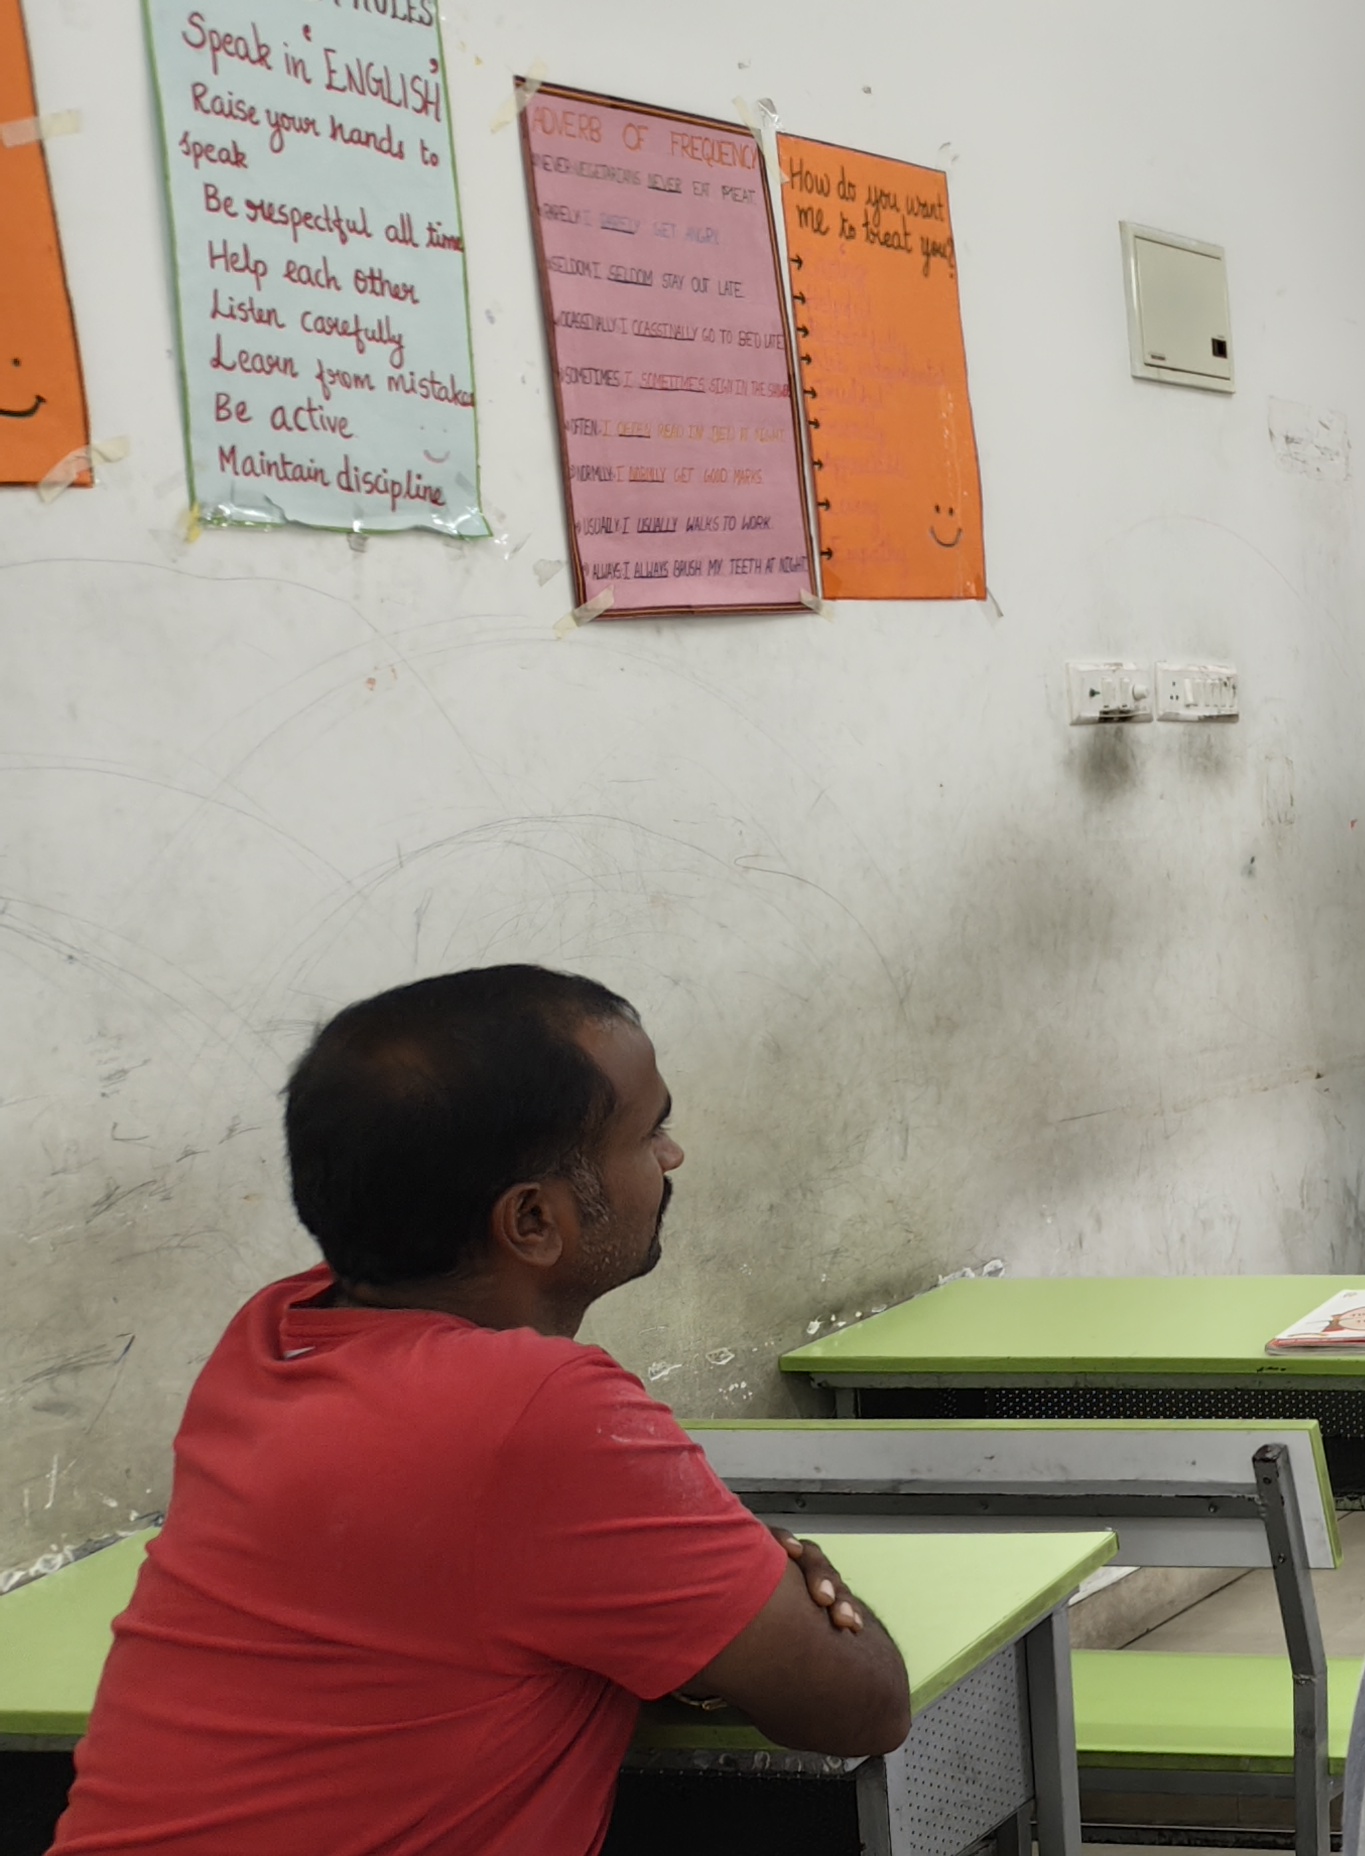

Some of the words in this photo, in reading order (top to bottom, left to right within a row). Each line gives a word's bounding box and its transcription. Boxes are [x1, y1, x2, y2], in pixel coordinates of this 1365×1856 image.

[181, 12, 272, 74] Speak
[284, 42, 312, 84] in
[179, 131, 248, 170] speak
[191, 83, 260, 125] Raise
[266, 108, 321, 153] your
[330, 114, 405, 161] hands
[419, 139, 440, 168] to
[533, 106, 601, 143] ADVERB
[621, 123, 650, 152] OF
[670, 131, 757, 169] FREQUENCY
[203, 183, 239, 219] Be
[245, 199, 373, 245] respectful
[385, 212, 419, 248] all
[789, 157, 831, 198] How
[837, 165, 857, 202] do
[866, 184, 900, 228] you
[905, 194, 945, 223] want
[796, 204, 831, 236] me
[838, 211, 857, 240] to
[862, 207, 913, 254] treat
[208, 240, 268, 291] Help
[283, 258, 341, 292] each
[353, 268, 420, 305] other
[211, 289, 286, 329] Listen
[300, 310, 405, 370] carefully
[719, 328, 733, 345] TO
[211, 334, 299, 379] Learn
[316, 358, 376, 400] from
[214, 392, 253, 424] Be
[270, 405, 354, 440] active
[218, 446, 331, 487] Maintain
[337, 455, 446, 512] discipline
[722, 515, 737, 531] TO
[729, 557, 762, 576] TEETH
